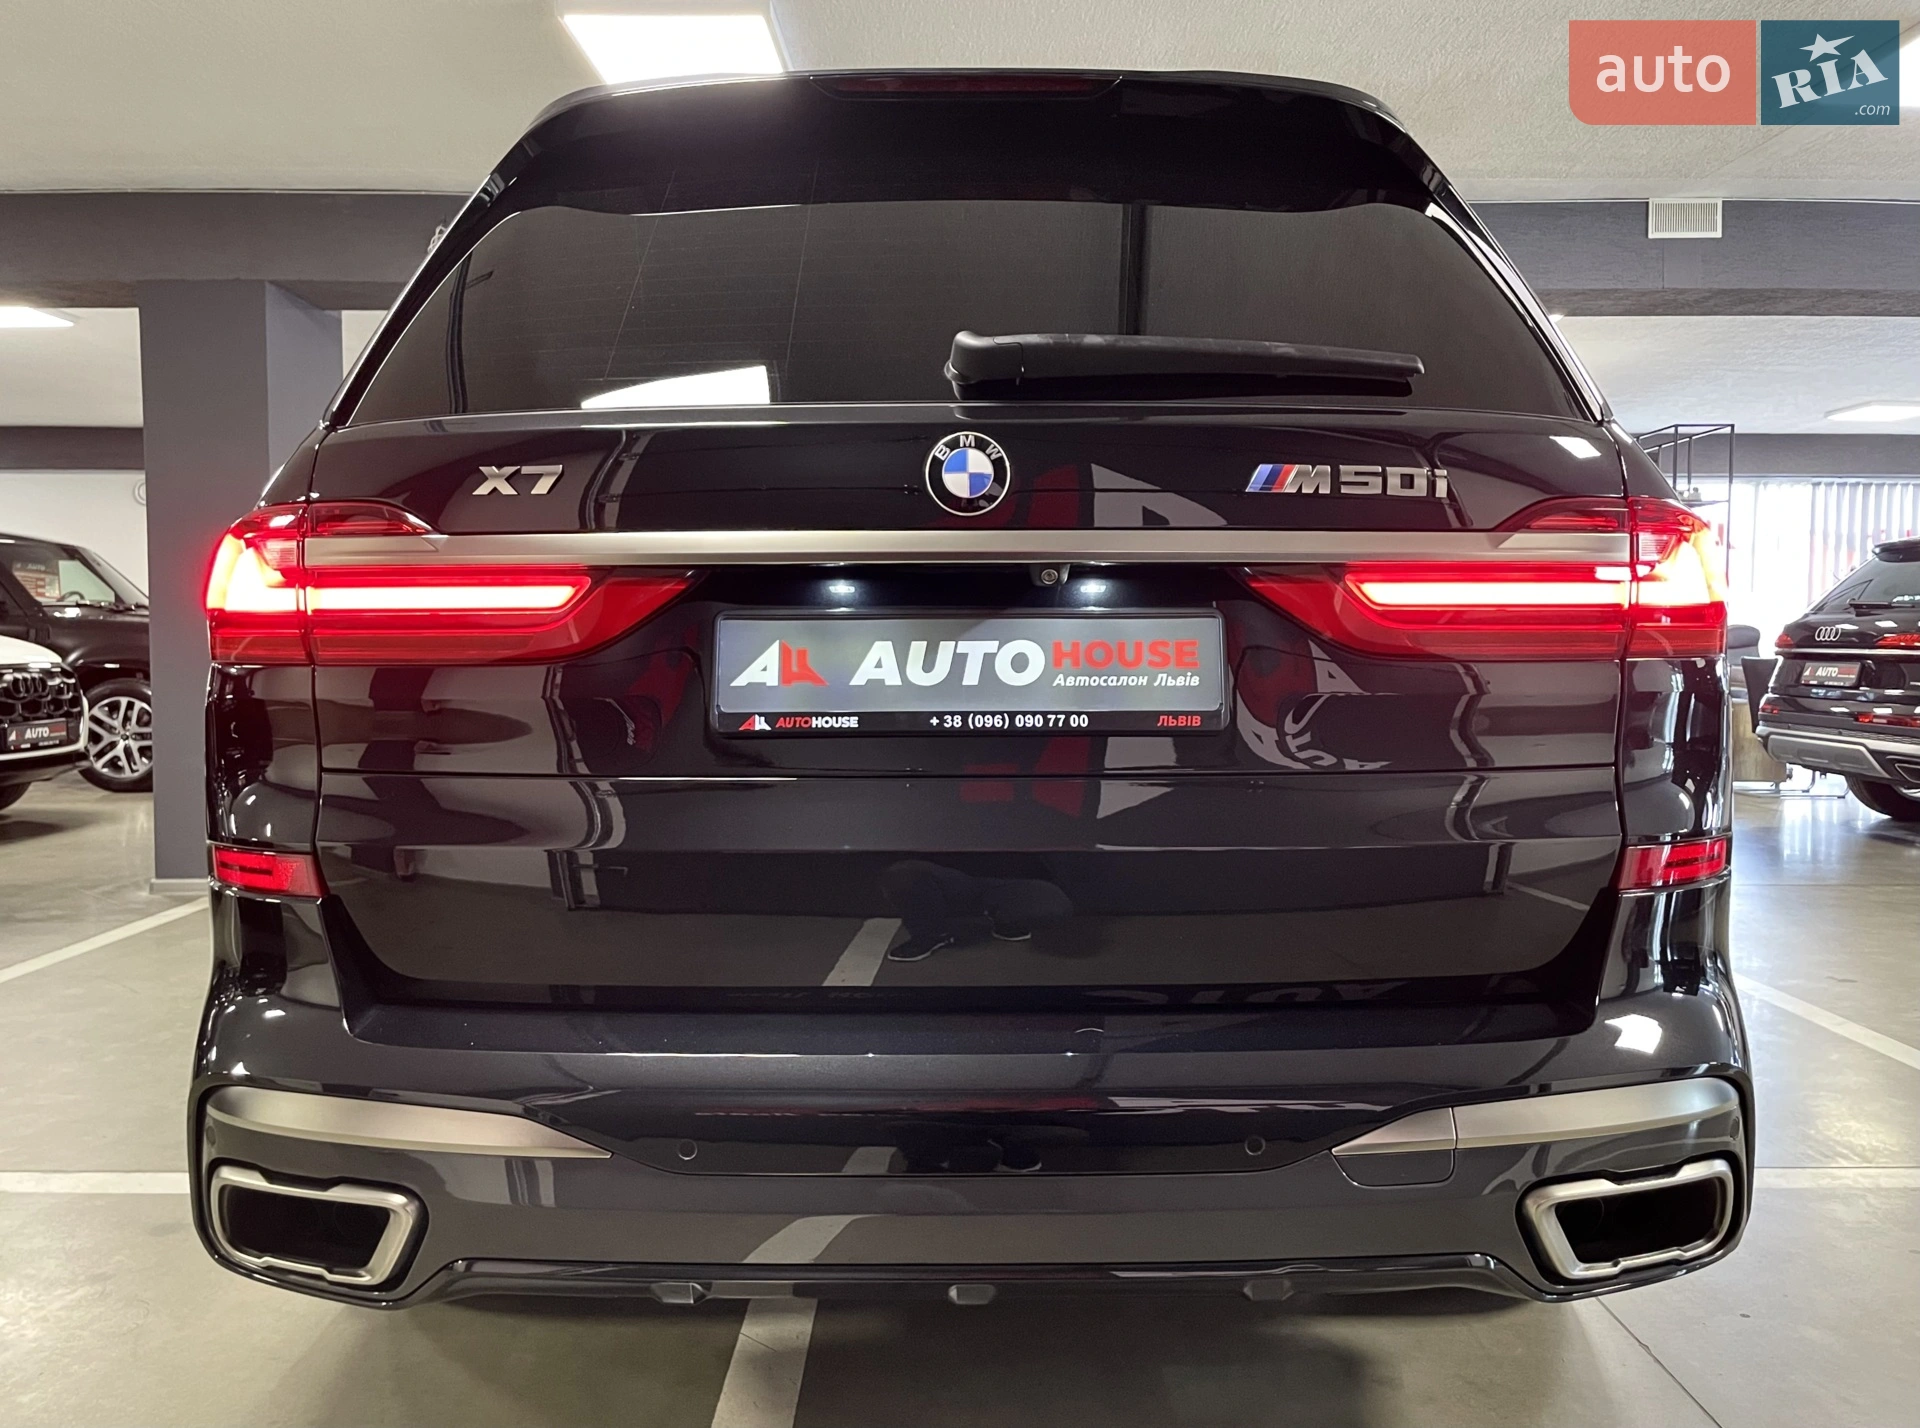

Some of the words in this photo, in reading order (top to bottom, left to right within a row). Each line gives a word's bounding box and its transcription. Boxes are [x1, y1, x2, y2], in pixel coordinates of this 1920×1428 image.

[934, 434, 1003, 461] BMW
[472, 464, 563, 495] X7
[849, 639, 1046, 687] AUTO
[1052, 639, 1200, 670] HOUSE
[1052, 673, 1149, 687] Автосалон
[1153, 671, 1200, 687] Львів
[775, 716, 859, 728] AUTOHOUSE
[967, 713, 1011, 729] (096)
[1015, 714, 1044, 728] 090
[1047, 714, 1066, 728] 77
[1069, 714, 1090, 728] 00
[1156, 715, 1202, 727] ЛЬВІВ
[24, 726, 50, 740] AUTO
